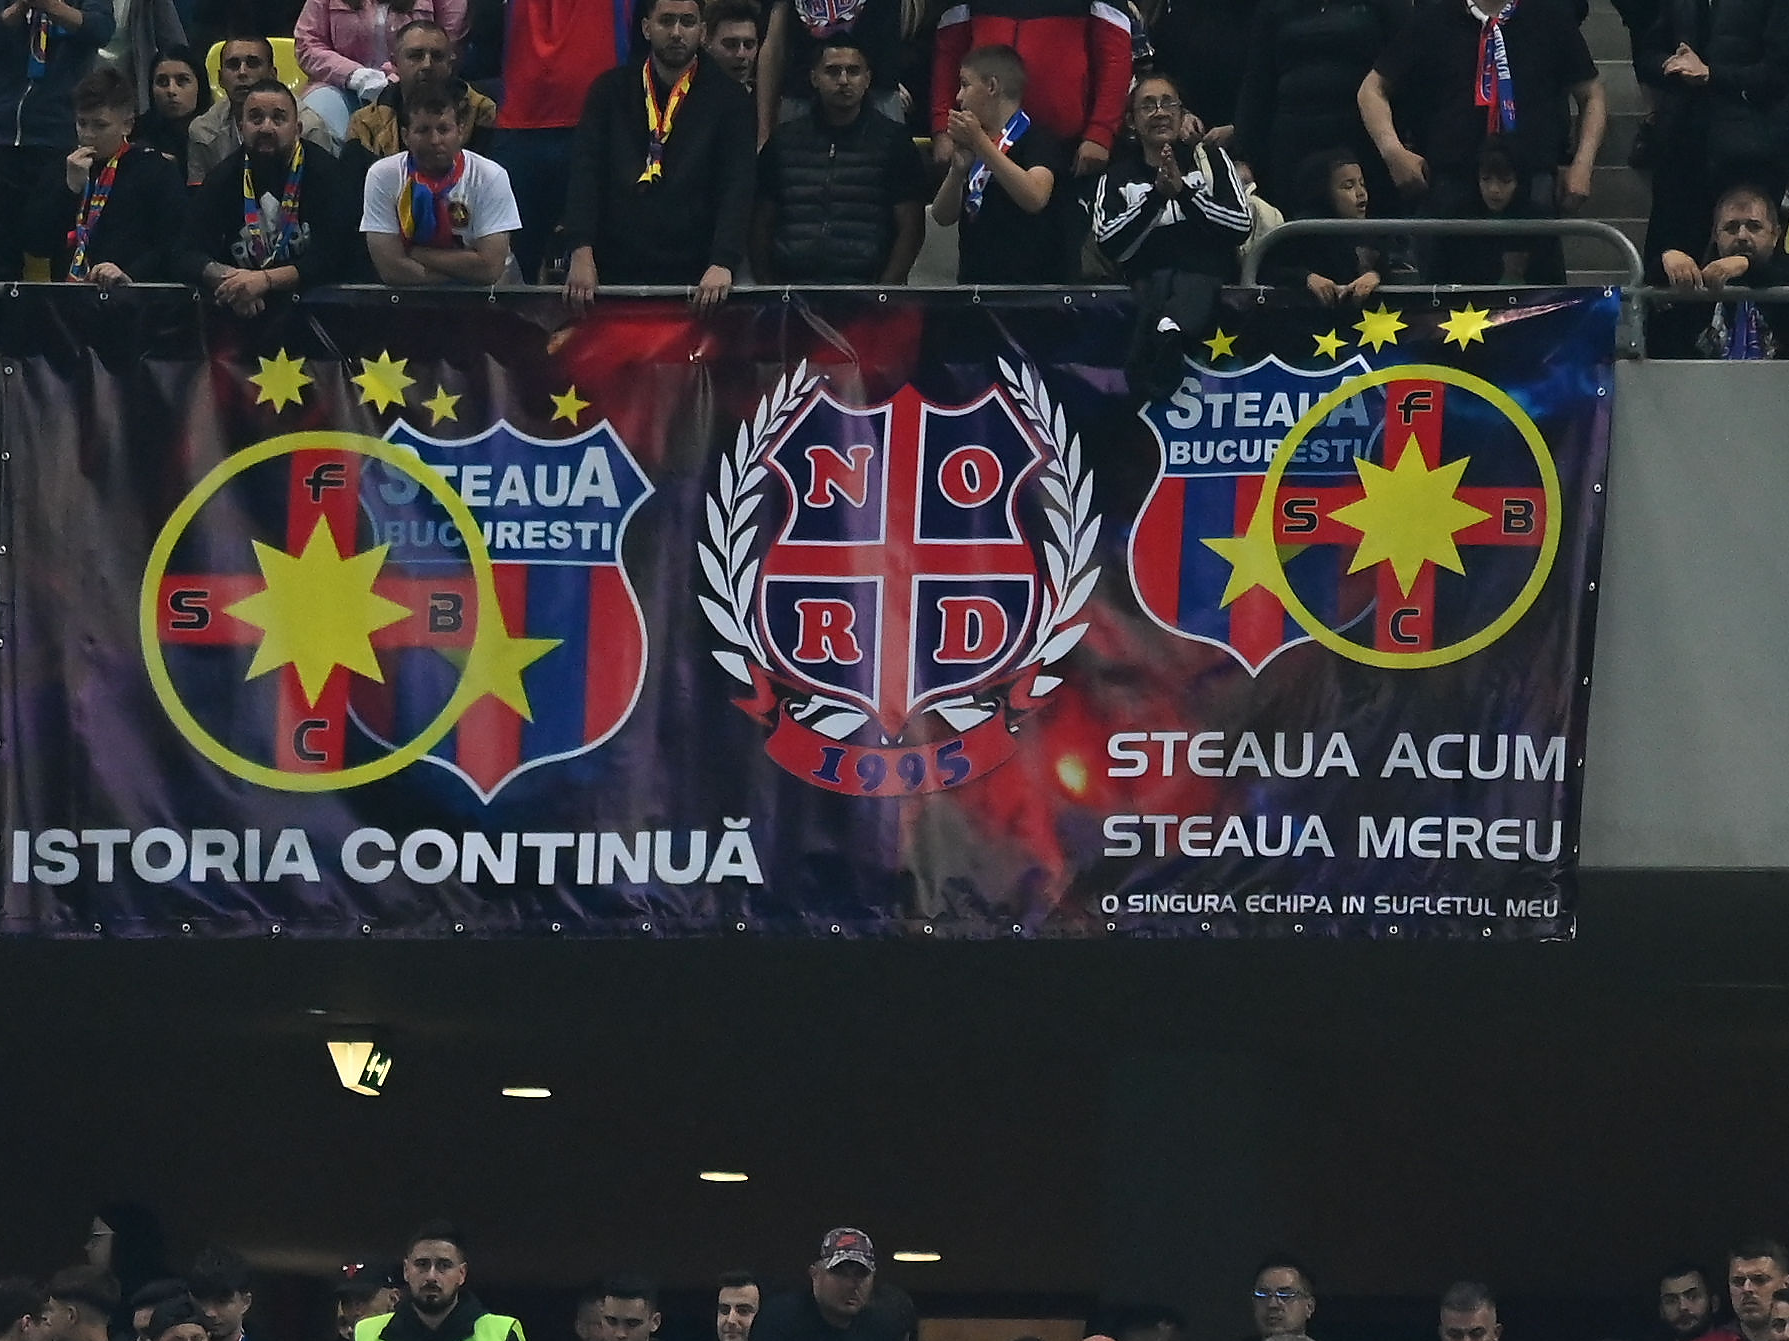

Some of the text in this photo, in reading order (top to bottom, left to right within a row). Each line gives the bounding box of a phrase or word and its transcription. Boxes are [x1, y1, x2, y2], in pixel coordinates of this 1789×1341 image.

[380, 443, 621, 509] STEAUA
[388, 520, 613, 553] BUCURESTI
[812, 740, 972, 792] 1995
[1107, 731, 1566, 783] STEAUA ACUM
[13, 815, 764, 887] ISTORIA CONTINUĂ
[1102, 814, 1562, 863] STEAUA MEREU
[1101, 894, 1559, 918] O SINGURA ECHIPA IN SUFLETUL MEU
